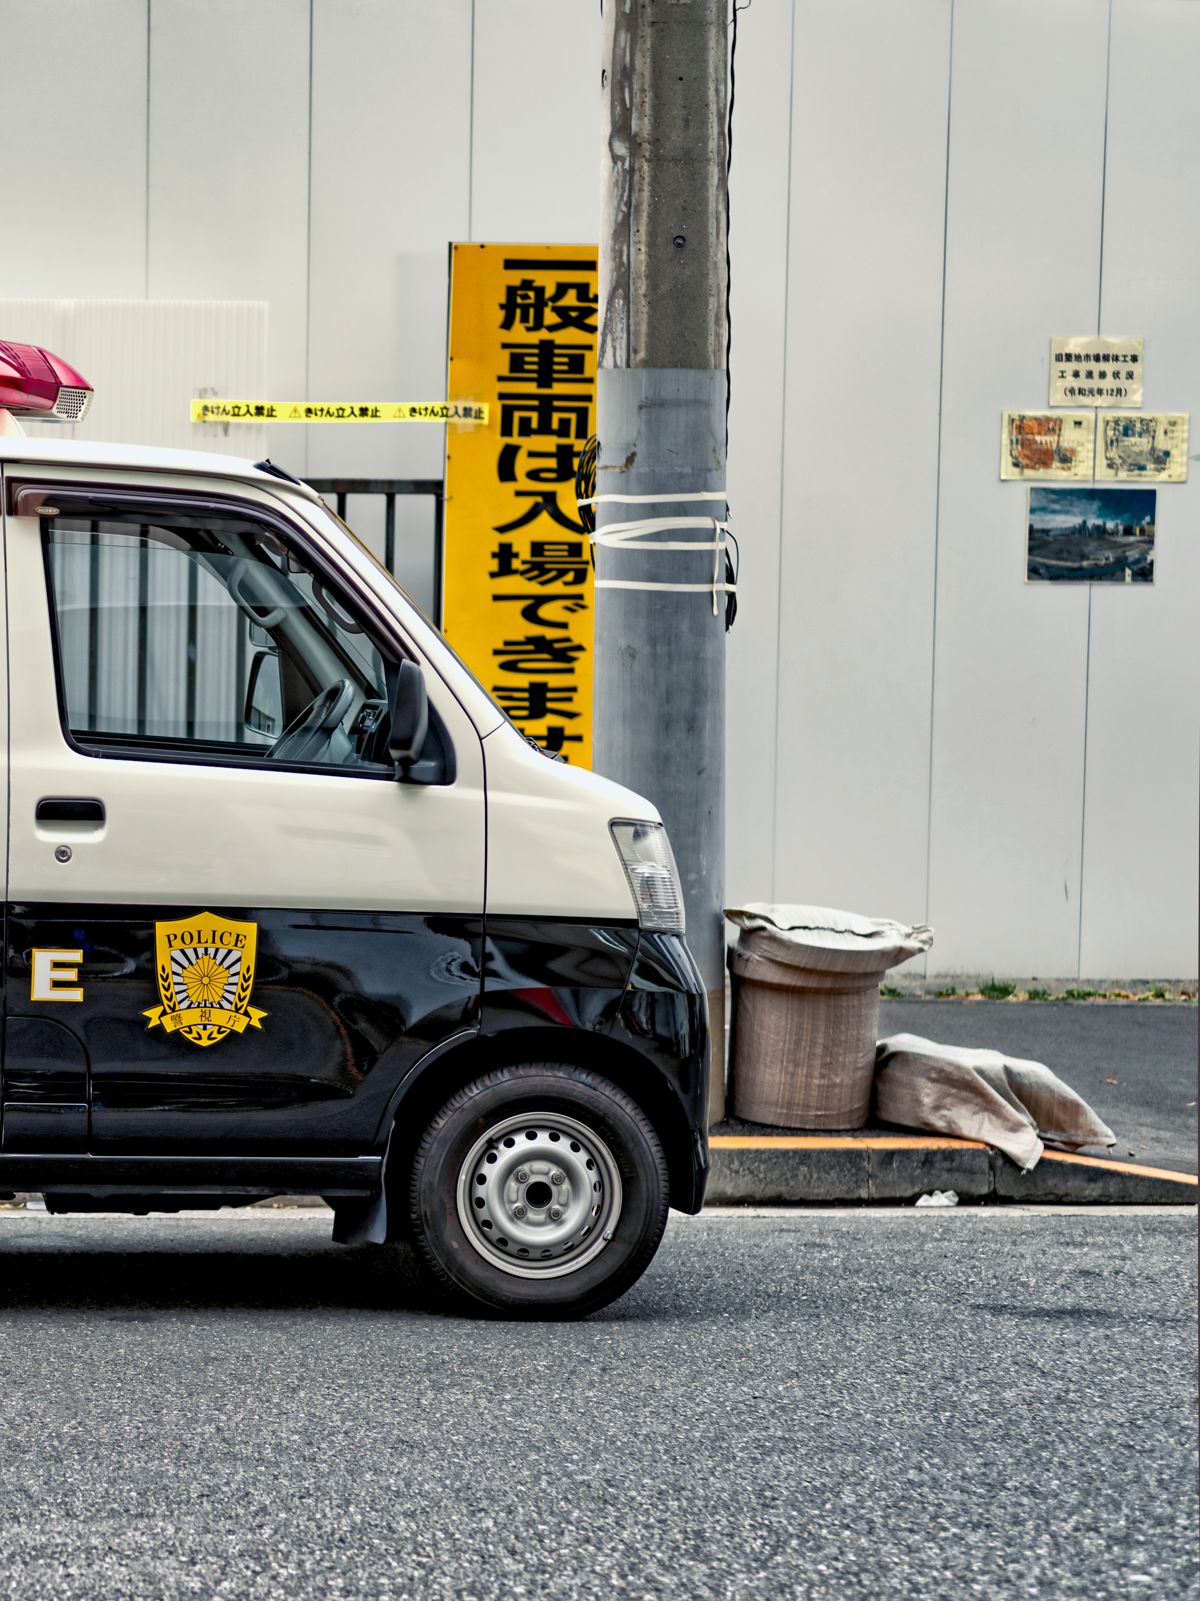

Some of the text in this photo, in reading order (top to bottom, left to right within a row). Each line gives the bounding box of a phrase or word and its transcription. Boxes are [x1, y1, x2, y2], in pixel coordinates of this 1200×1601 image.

[201, 404, 485, 421] きけん立入禁止 きけん立入禁止 きけん立入禁止
[165, 930, 247, 949] POLICE
[169, 1009, 241, 1028] 警視庁
